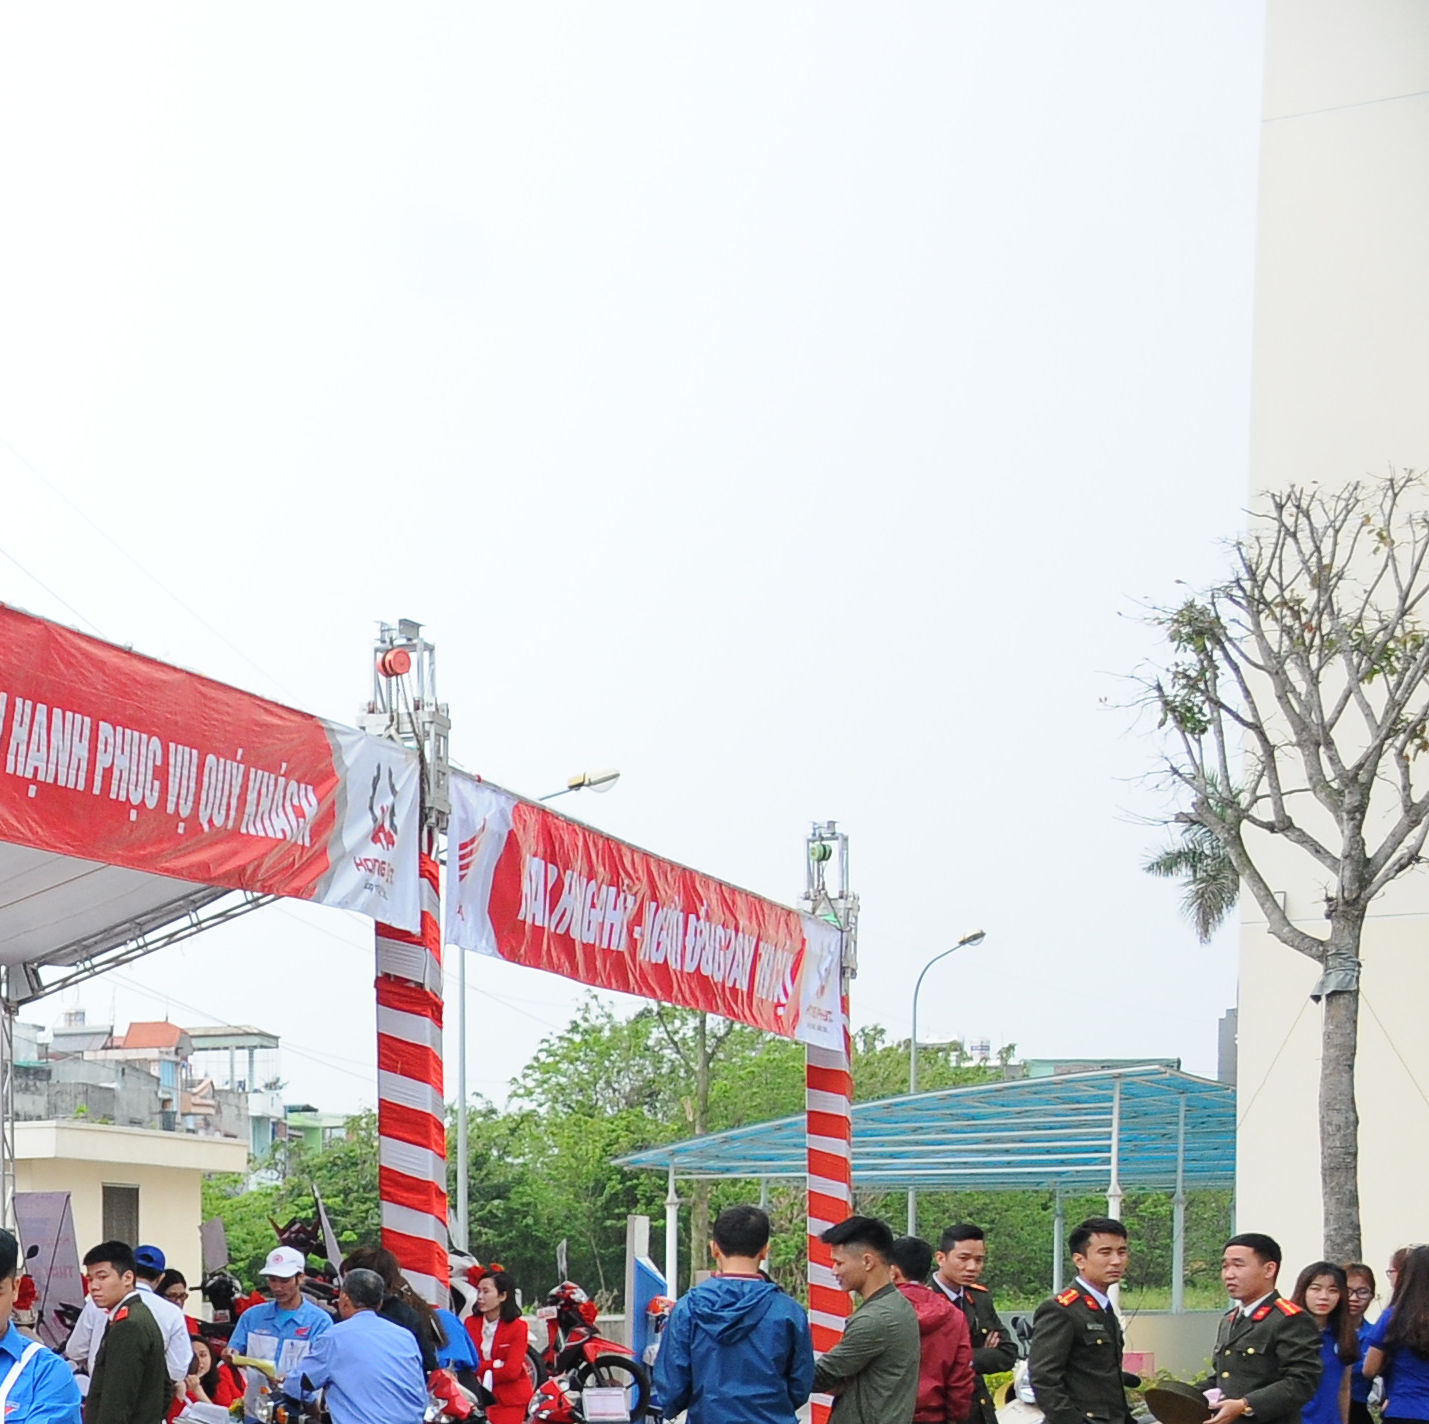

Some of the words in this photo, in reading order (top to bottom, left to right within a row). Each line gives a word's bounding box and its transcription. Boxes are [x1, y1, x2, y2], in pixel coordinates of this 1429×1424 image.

[5, 696, 91, 798] HẠNH
[92, 720, 163, 822] PHỤC
[166, 741, 199, 834] VỤ
[198, 747, 245, 833] QUÝ
[240, 761, 319, 847] KHÁCH
